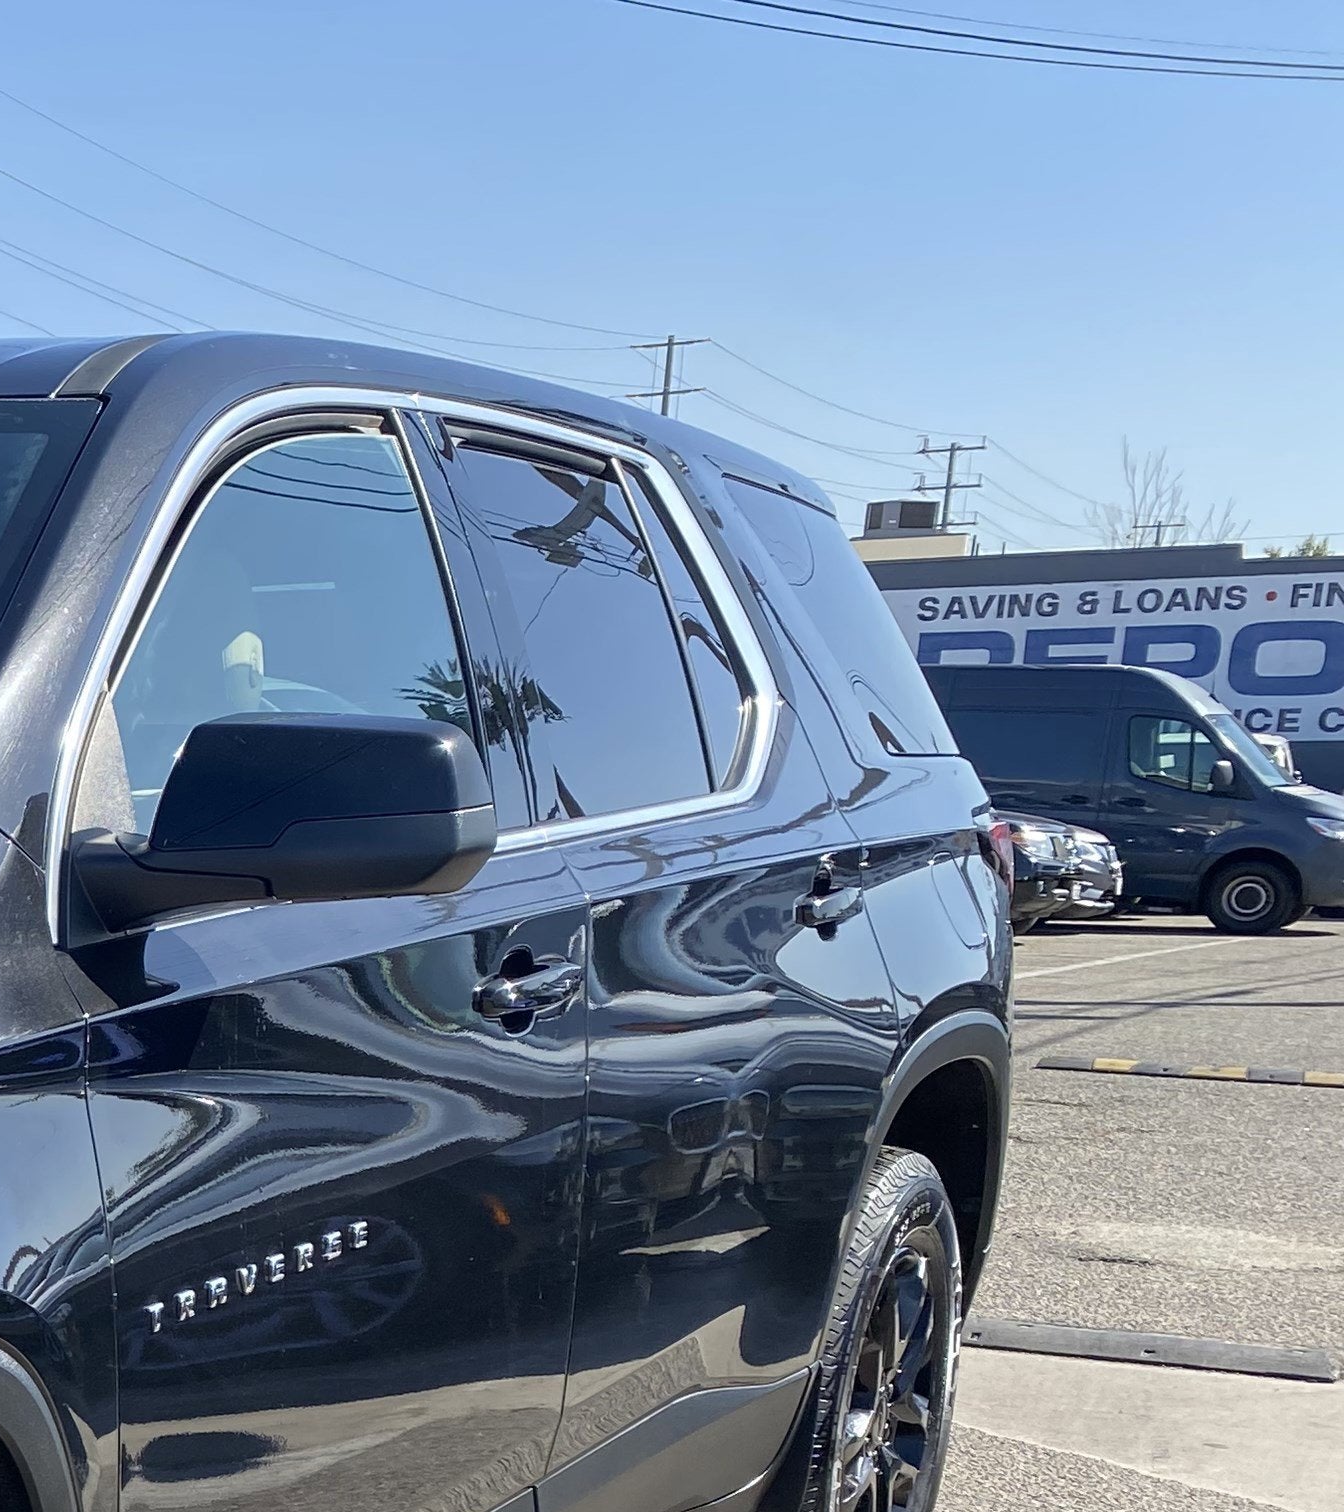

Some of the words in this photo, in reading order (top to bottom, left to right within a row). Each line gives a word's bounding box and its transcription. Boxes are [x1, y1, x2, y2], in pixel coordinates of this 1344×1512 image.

[916, 592, 1061, 622] SAVING
[1076, 590, 1101, 616] &
[1111, 585, 1249, 614] LOANS
[1290, 582, 1344, 608] FIN
[142, 1220, 369, 1334] TRAVERSE
